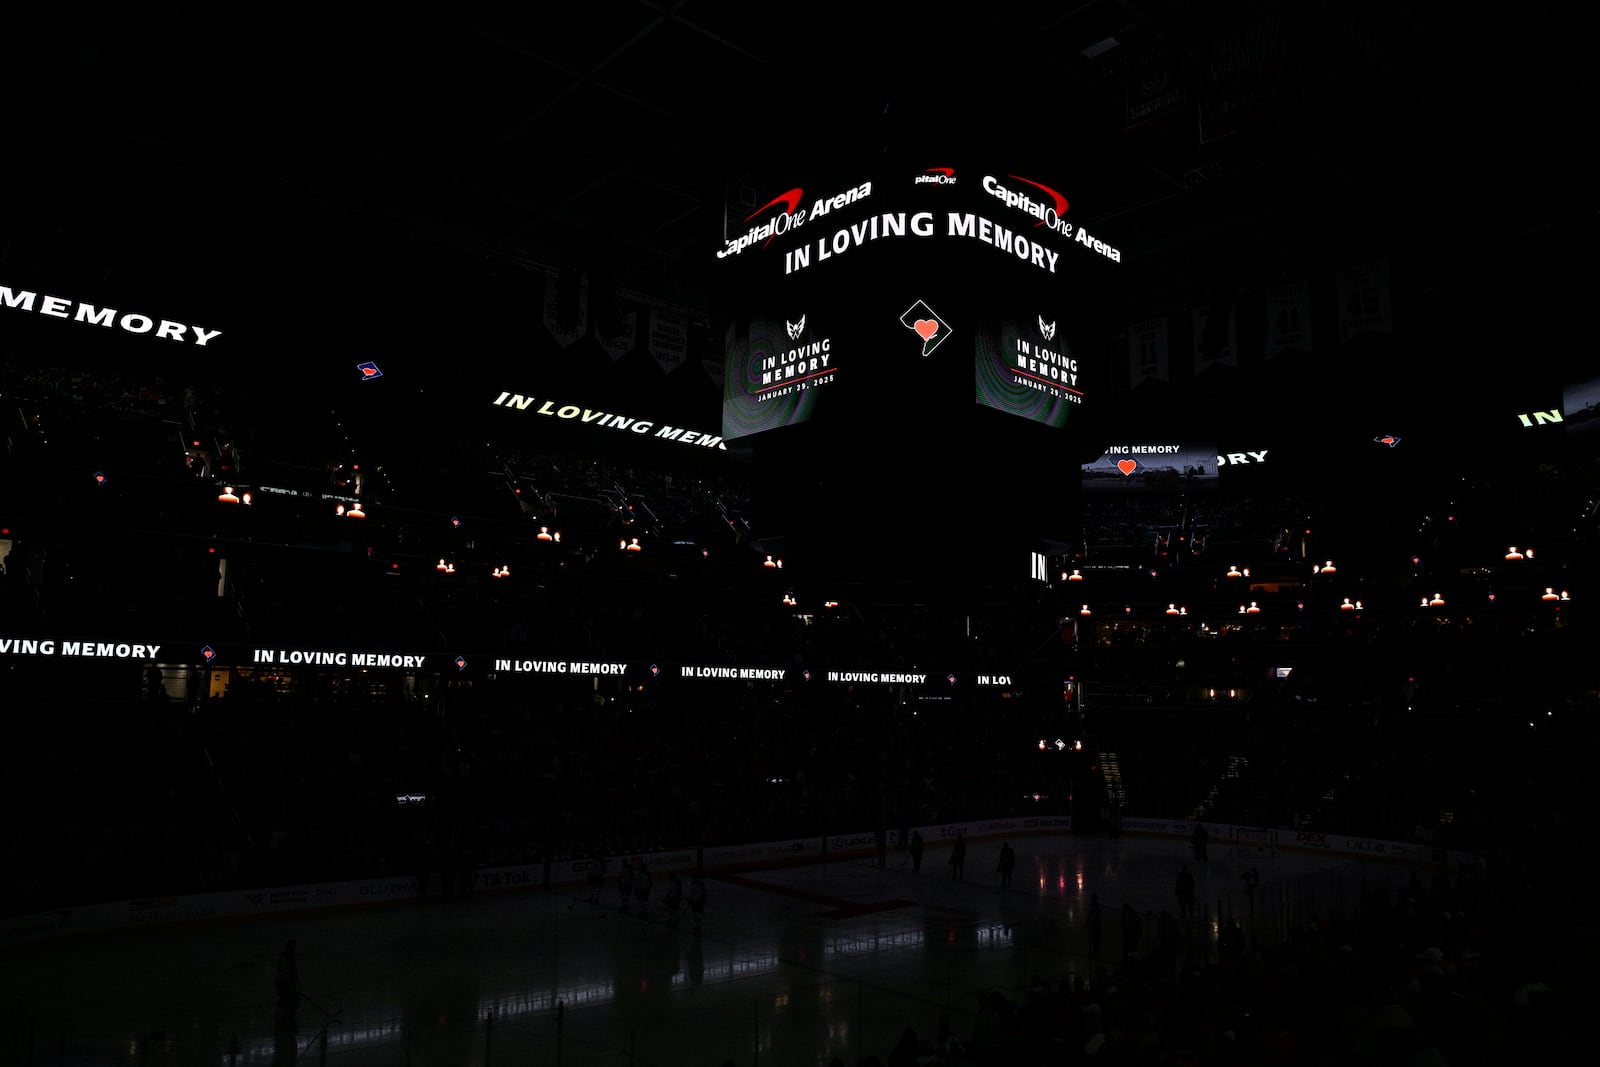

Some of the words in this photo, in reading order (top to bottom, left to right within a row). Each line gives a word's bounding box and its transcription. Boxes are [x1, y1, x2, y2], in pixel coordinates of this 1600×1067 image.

[809, 182, 871, 221] Arena
[786, 245, 810, 274] IN
[819, 212, 934, 261] LOVING
[948, 212, 1059, 273] MEMORY
[1075, 228, 1121, 263] Arena
[0, 286, 222, 346] MEMORY
[763, 356, 775, 370] IN
[781, 339, 830, 364] LOVING
[1017, 339, 1029, 354] IN
[1035, 346, 1077, 371] LOVING
[763, 354, 829, 384] MEMORY
[1018, 355, 1077, 385] MEMORY
[758, 387, 792, 402] JANUARY
[814, 375, 833, 386] 2025
[1014, 376, 1046, 391] JANUARY
[1065, 393, 1081, 403] 2025
[493, 392, 535, 410] IN
[537, 402, 653, 434] LOVING
[1518, 409, 1563, 427] IN
[1132, 445, 1180, 454] MEMORY
[1032, 552, 1046, 581] IN
[62, 641, 160, 658] MEMORY
[254, 650, 274, 662] IN
[280, 651, 347, 665] LOVING
[352, 654, 425, 667] MEMORY
[495, 660, 511, 671] IN
[515, 661, 567, 673] LOVING
[570, 662, 627, 675] MEMORY
[682, 667, 694, 676] IN
[697, 667, 738, 678] LOVING
[740, 669, 785, 680] MEMORY
[828, 672, 838, 681] IN
[840, 672, 878, 682] LOVING
[880, 674, 926, 684] MEMORY
[977, 676, 990, 684] IN
[481, 870, 530, 887] TikTok
